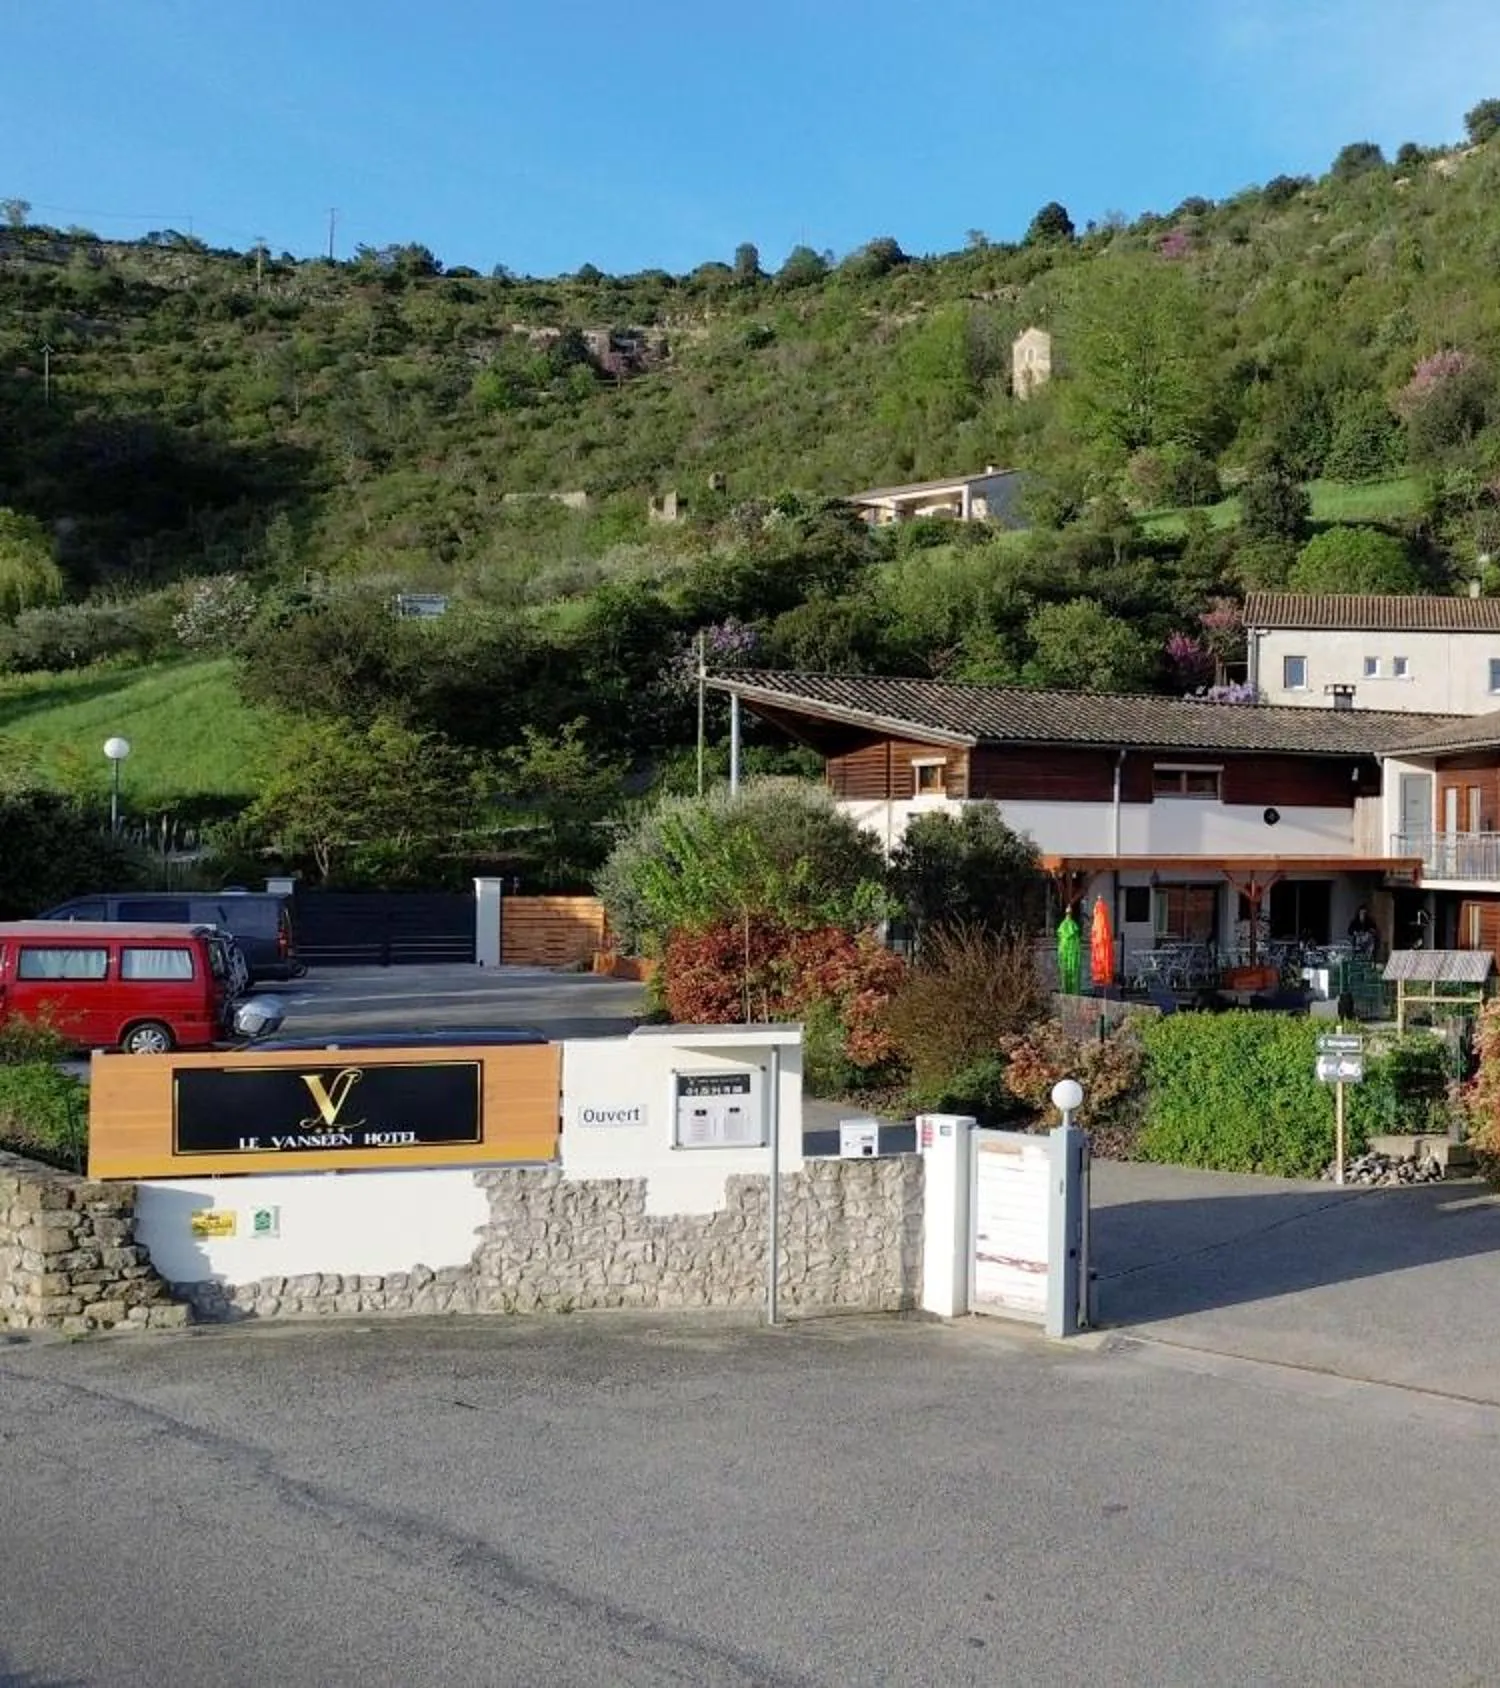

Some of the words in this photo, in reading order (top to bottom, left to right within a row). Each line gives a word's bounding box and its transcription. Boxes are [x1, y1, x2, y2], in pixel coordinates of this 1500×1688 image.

[583, 1107, 640, 1123] Ouvert
[239, 1137, 260, 1149] LE
[271, 1133, 353, 1149] VANSEEN
[364, 1131, 418, 1145] HOTEL
